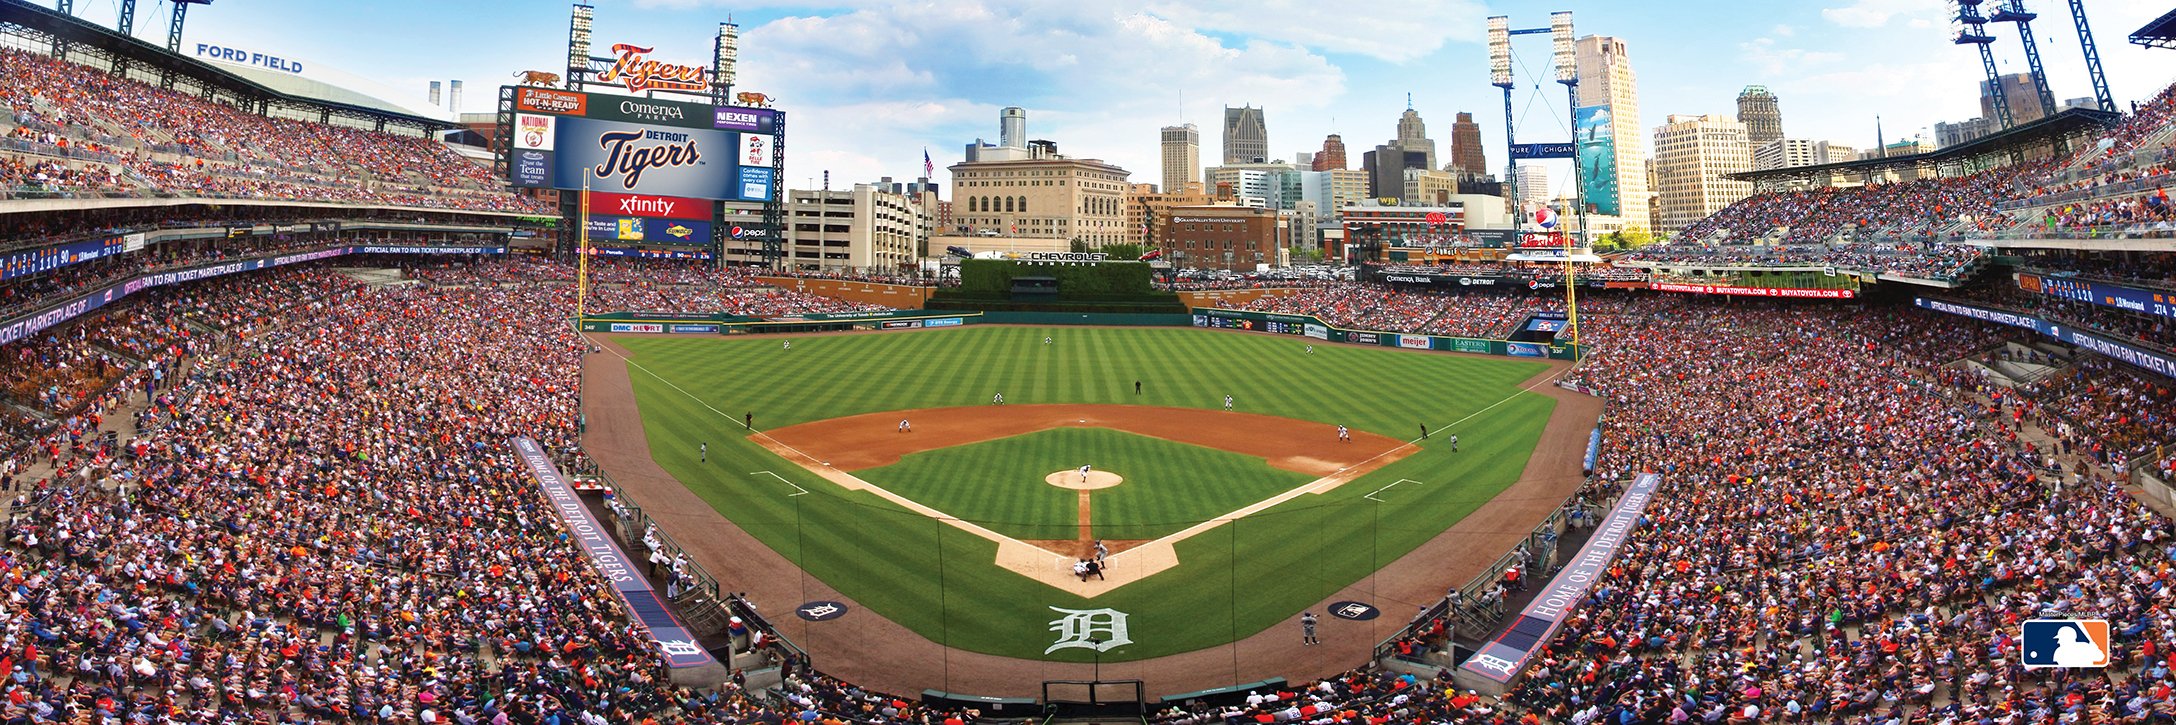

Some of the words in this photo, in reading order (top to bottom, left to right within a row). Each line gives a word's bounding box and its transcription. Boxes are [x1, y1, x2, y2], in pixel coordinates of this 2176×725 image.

[196, 43, 247, 62] FORD
[252, 53, 303, 73] FIELD
[597, 43, 708, 93] Tigers
[523, 98, 580, 110] HOT-N-READY
[522, 116, 548, 128] NATIONAL
[717, 112, 757, 122] NEXEN
[646, 130, 689, 142] DETROIT
[1528, 143, 1573, 158] MICHIGAN
[595, 128, 702, 190] Tigers
[520, 164, 545, 174] Team
[620, 196, 675, 216] xfinity
[1380, 197, 1398, 205] WJR
[1426, 212, 1446, 223] AAA
[666, 227, 693, 236] SUNOCO
[744, 229, 766, 239] pepsi
[61, 250, 69, 264] 90
[1031, 252, 1108, 262] CHEVROLET
[124, 278, 142, 294] OFFICIAL
[142, 276, 153, 288] FAN
[154, 274, 163, 286] TO
[164, 272, 176, 284] FAN
[177, 269, 198, 282] TICKET
[199, 264, 235, 278] MARKETPLACE
[236, 262, 243, 272] OF
[1660, 284, 1704, 292] BUYATOYOTA.COM
[1716, 288, 1766, 296] BUYATOYOTA.COM
[1781, 290, 1838, 298] BUYATOYOTA.COM
[25, 302, 78, 334] MARKETPLACE
[78, 300, 88, 314] OF
[1931, 301, 1948, 312] OFFICIAL
[1948, 304, 1956, 314] FAN
[1956, 305, 1962, 314] TO
[1962, 306, 1972, 316] FAN
[1972, 308, 1990, 320] TICKET
[1990, 311, 2030, 328] MARKETPLACE
[2031, 319, 2036, 328] OF
[1402, 338, 1427, 346] meijer
[1456, 339, 1486, 347] EASTERN
[2072, 333, 2098, 350] OFFICIAL
[2098, 340, 2111, 355] FAN
[2111, 344, 2120, 357] TO
[2121, 346, 2136, 363] FAN
[2136, 352, 2166, 373] TICKET
[528, 455, 551, 475] HOME
[542, 475, 560, 486] OF
[549, 486, 572, 501] THE
[561, 502, 602, 542] DETROIT
[1532, 585, 1579, 618] HOME
[1568, 569, 1592, 583] OF
[1580, 550, 1606, 567] THE
[1594, 514, 1632, 548] DETROIT
[1618, 492, 1646, 514] TIGERS
[592, 544, 633, 582] TIGERS
